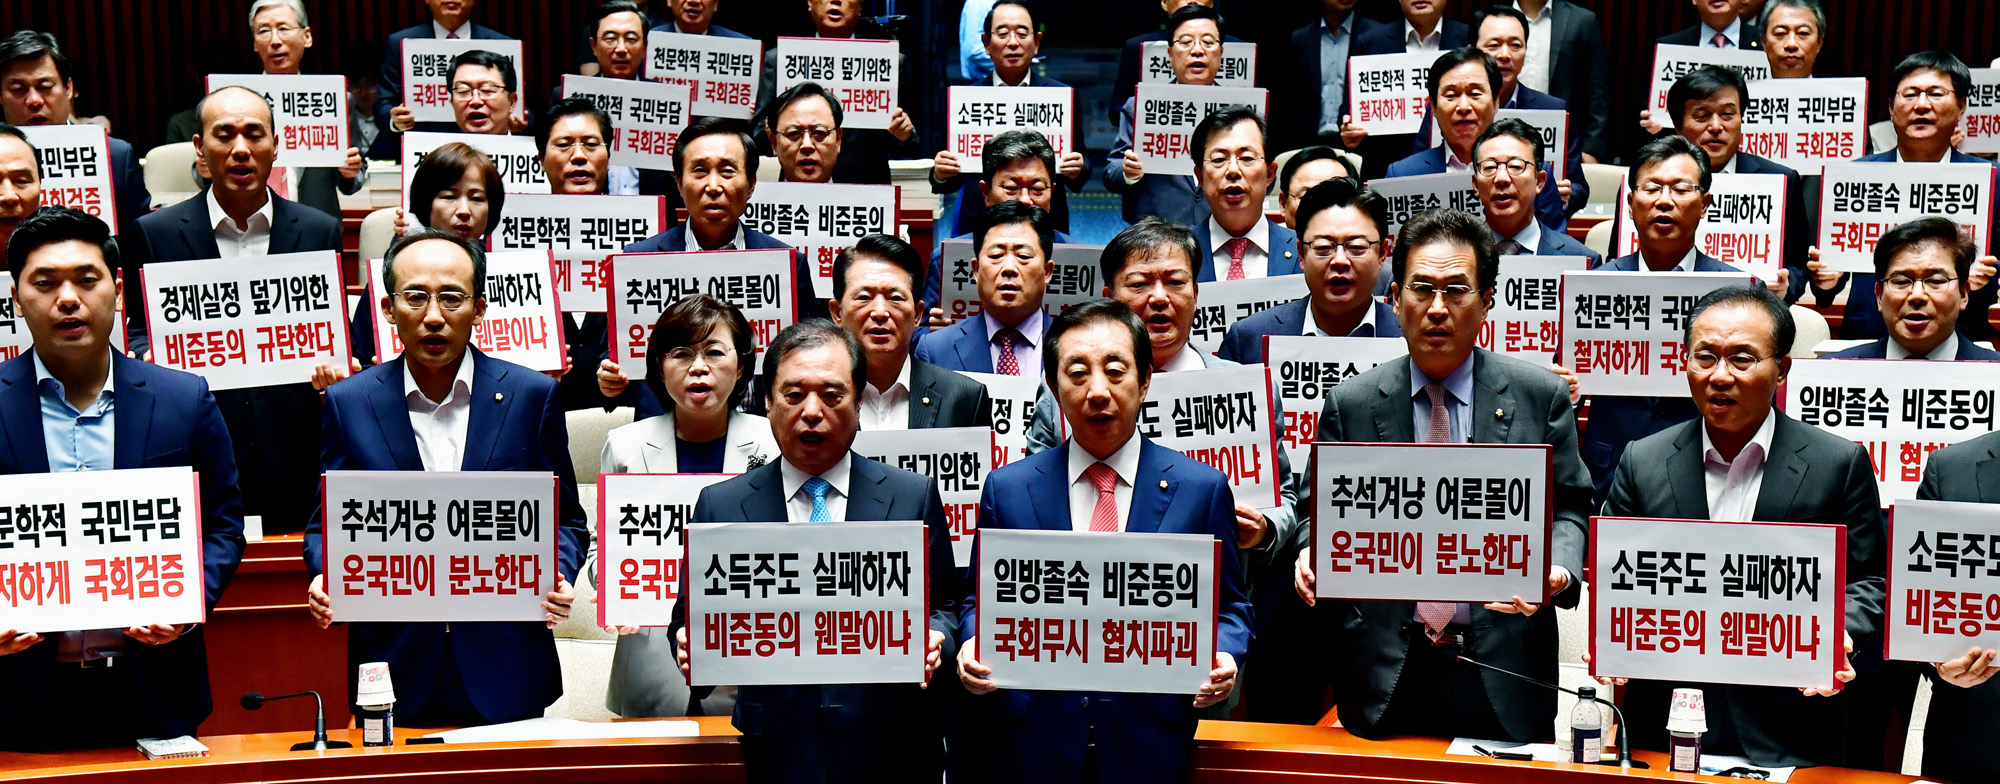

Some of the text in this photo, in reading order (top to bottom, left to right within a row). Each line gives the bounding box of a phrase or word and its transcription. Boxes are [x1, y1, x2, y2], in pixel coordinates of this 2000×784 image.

[411, 54, 456, 77] 일방졸
[653, 47, 754, 77] 천문학적 국민부담
[785, 55, 891, 82] 경제실정 덮기위한
[1149, 56, 1176, 79] 추석
[705, 80, 751, 106] 국회검증
[1358, 69, 1405, 93] 천문학적
[282, 92, 338, 117] 비준동의
[629, 97, 682, 126] 국민부담
[841, 87, 891, 113] 규탄한다
[958, 103, 1064, 127] 소득주도 실패하자
[1145, 99, 1198, 127] 일방졸속
[1359, 98, 1406, 122] 철저하게
[1741, 97, 1857, 124] 문학적 국민부담
[283, 124, 339, 151] 협치파괴
[1796, 132, 1854, 158] 국회검증
[486, 153, 546, 184] 기위한
[1707, 194, 1773, 225] 실패하자
[1833, 181, 1979, 215] 일방졸속 비준동의
[502, 216, 571, 250] 천문학적
[744, 203, 885, 238] 일방졸속 비준동의
[1704, 233, 1771, 264] 웬말이냐
[158, 274, 330, 323] 경제실정 덮기위한
[483, 272, 542, 309] 패하자
[1574, 294, 1651, 331] 천문학적
[165, 321, 335, 370] 비준동의 규탄한다
[474, 315, 547, 353] 웬말이냐
[1573, 339, 1650, 375] 철저하게
[1171, 391, 1257, 438] 실패하자
[1799, 386, 1995, 432] 일방졸속 비준동의
[1331, 475, 1531, 522] 추석겨냥 여론몰이
[81, 497, 181, 544] 국민부담
[341, 499, 540, 542] 추석겨냥 여론몰이
[619, 503, 693, 546] 추석겨
[1331, 530, 1531, 577] 온국민이 분노한다
[84, 554, 185, 602] 국회검증
[342, 554, 542, 596] 온국민이 분노한다
[704, 551, 911, 599] 소득주도 실패하자
[994, 558, 1198, 608] 일방졸속 비준동의
[1611, 549, 1821, 602] 소득주도 실패하자
[704, 610, 911, 658] 비준동의 웬말이냐
[994, 617, 1198, 666] 국회무시 협치파괴
[1610, 606, 1821, 660] 비준동의 웬말이냐
